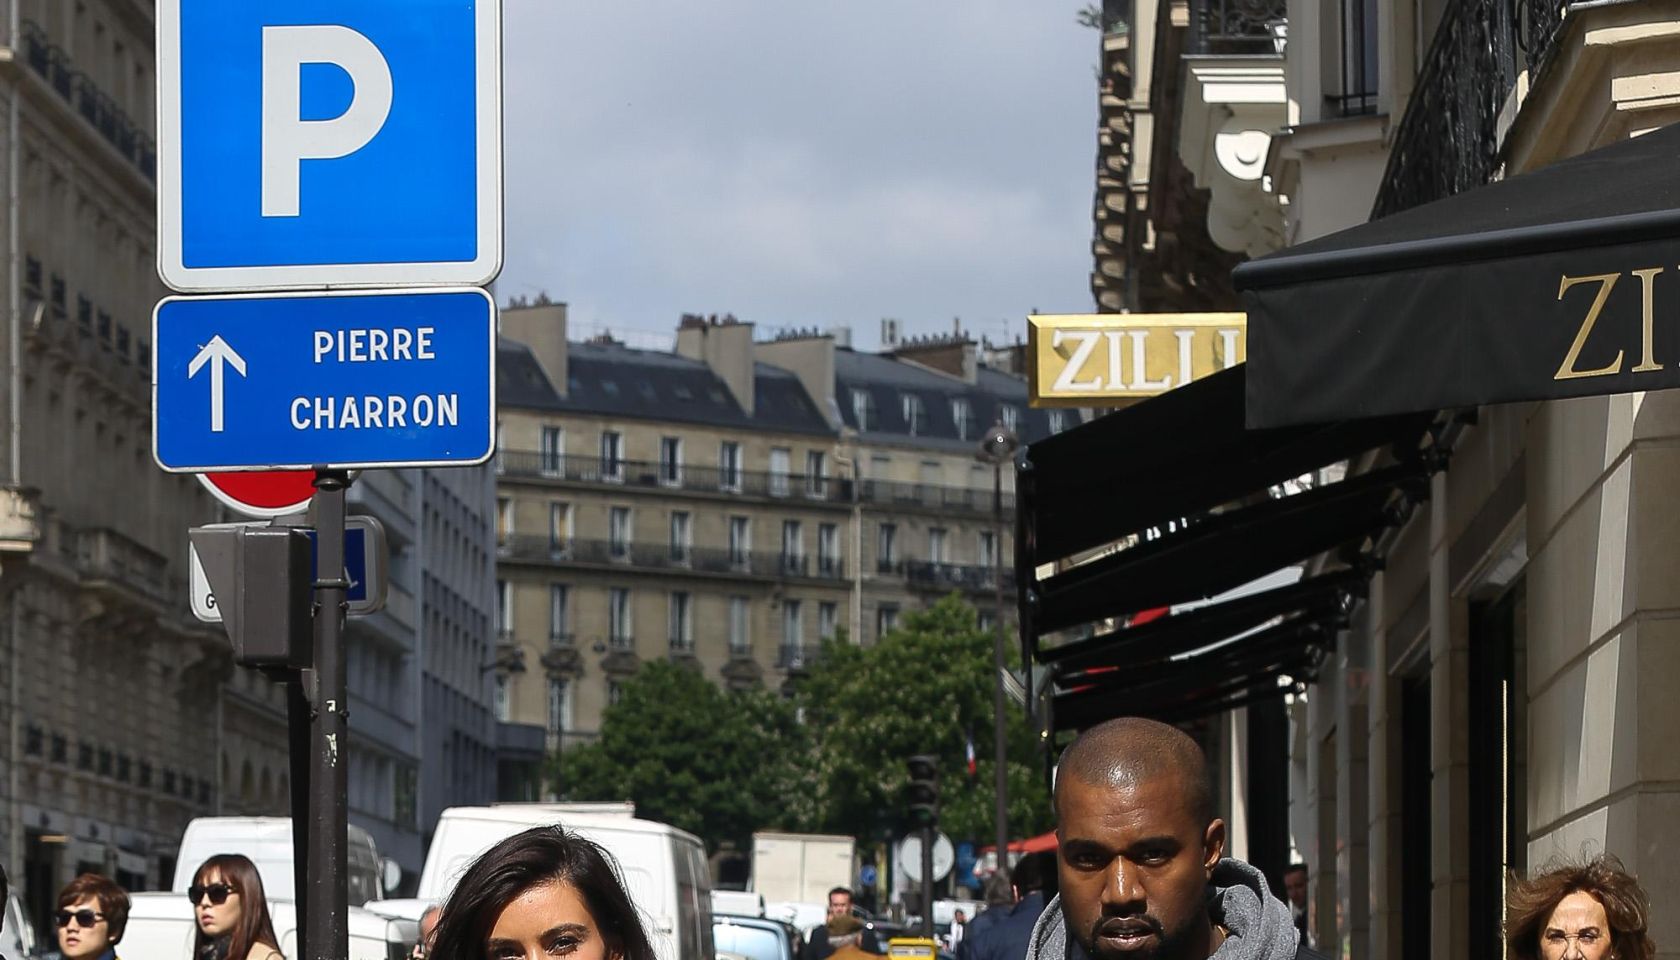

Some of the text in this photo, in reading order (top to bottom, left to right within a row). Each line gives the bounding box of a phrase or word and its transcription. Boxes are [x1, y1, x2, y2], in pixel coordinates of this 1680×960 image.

[262, 25, 393, 217] P
[314, 327, 435, 363] PIERRE
[1554, 265, 1680, 380] ZI
[290, 394, 458, 430] CHARRON
